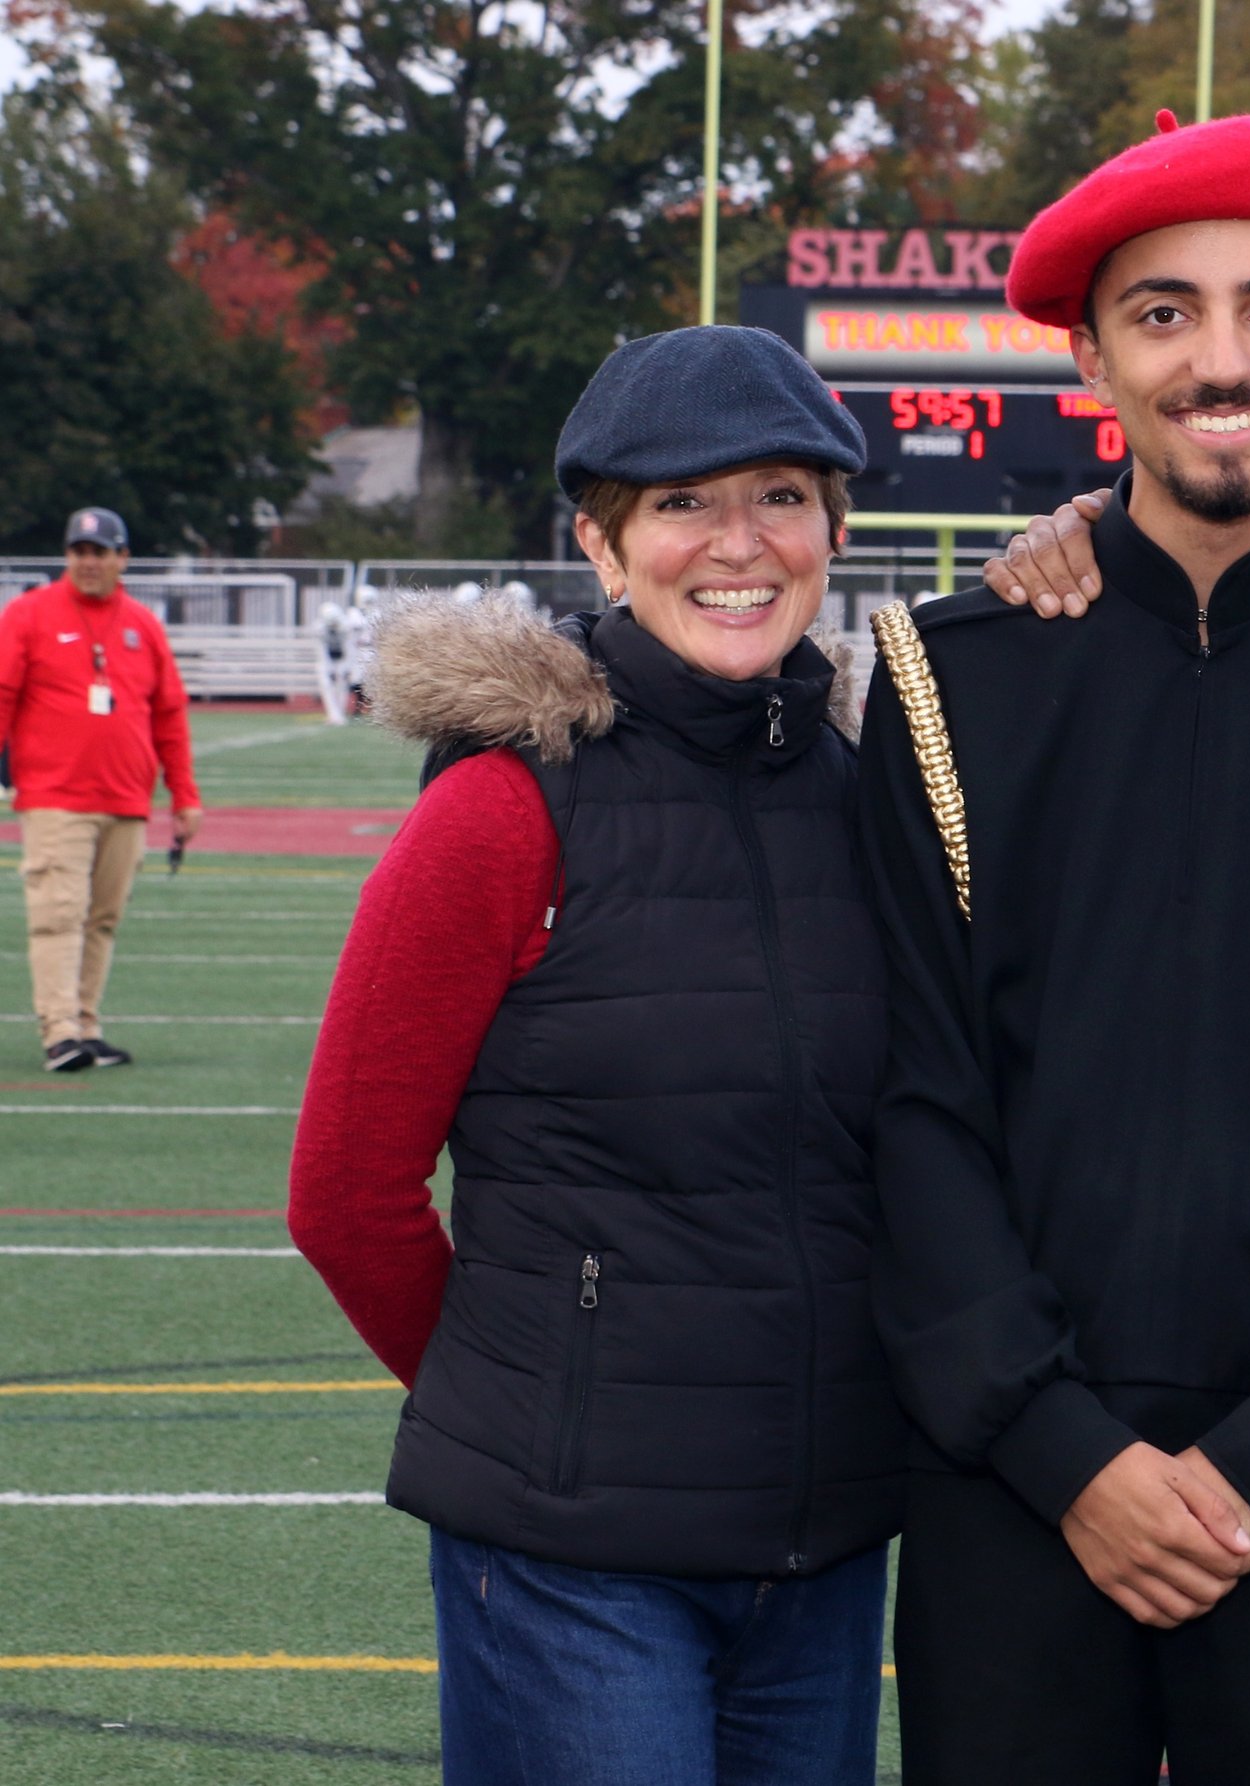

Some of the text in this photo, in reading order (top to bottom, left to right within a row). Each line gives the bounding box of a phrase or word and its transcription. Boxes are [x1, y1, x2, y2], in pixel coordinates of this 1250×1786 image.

[787, 229, 1024, 289] SHAK
[819, 312, 970, 351] THANK
[891, 388, 1002, 430] 59:57
[901, 434, 963, 456] PERIOD
[969, 430, 984, 460] 1
[1096, 420, 1127, 461] 0
